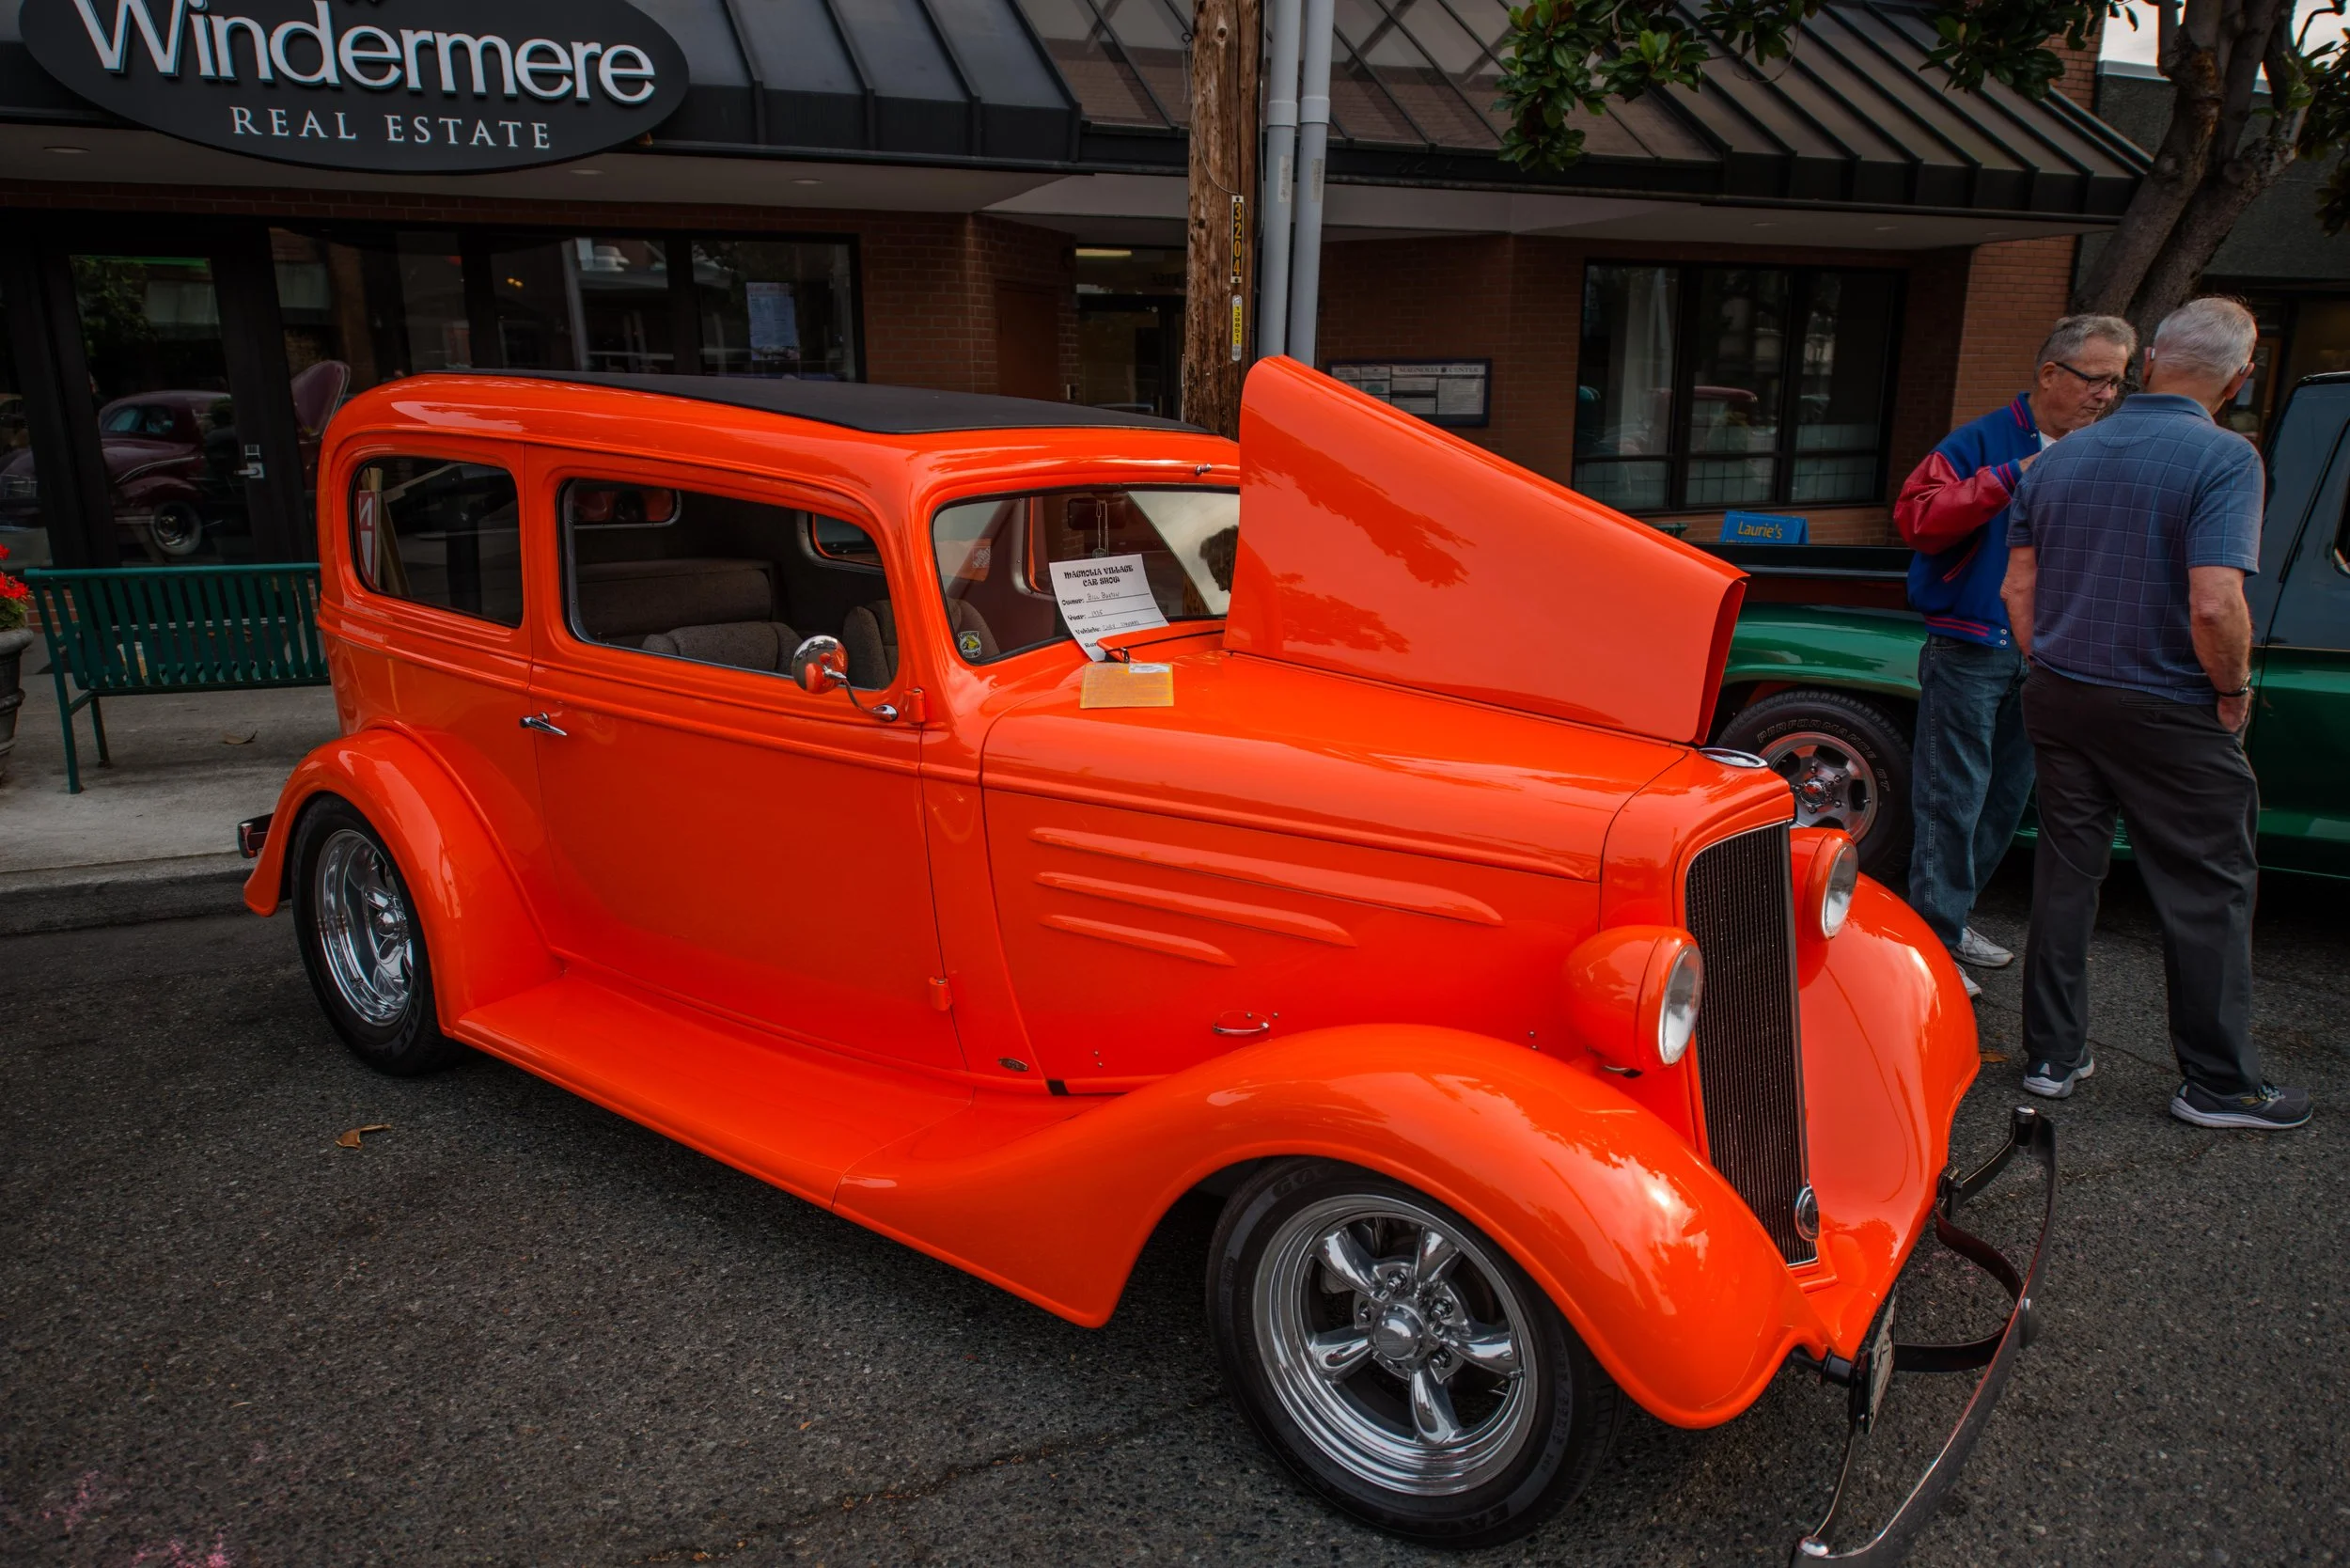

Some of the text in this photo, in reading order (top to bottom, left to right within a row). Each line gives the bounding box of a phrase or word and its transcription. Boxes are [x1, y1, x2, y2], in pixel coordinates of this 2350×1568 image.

[72, 0, 655, 105] Windermere
[229, 105, 551, 149] REAL ESTATE
[1232, 202, 1243, 276] 3204
[1737, 521, 1783, 540] Laurie's
[1063, 565, 1134, 579] MAGNOLIA VILLAGE
[1082, 575, 1120, 588] CAR SHOW
